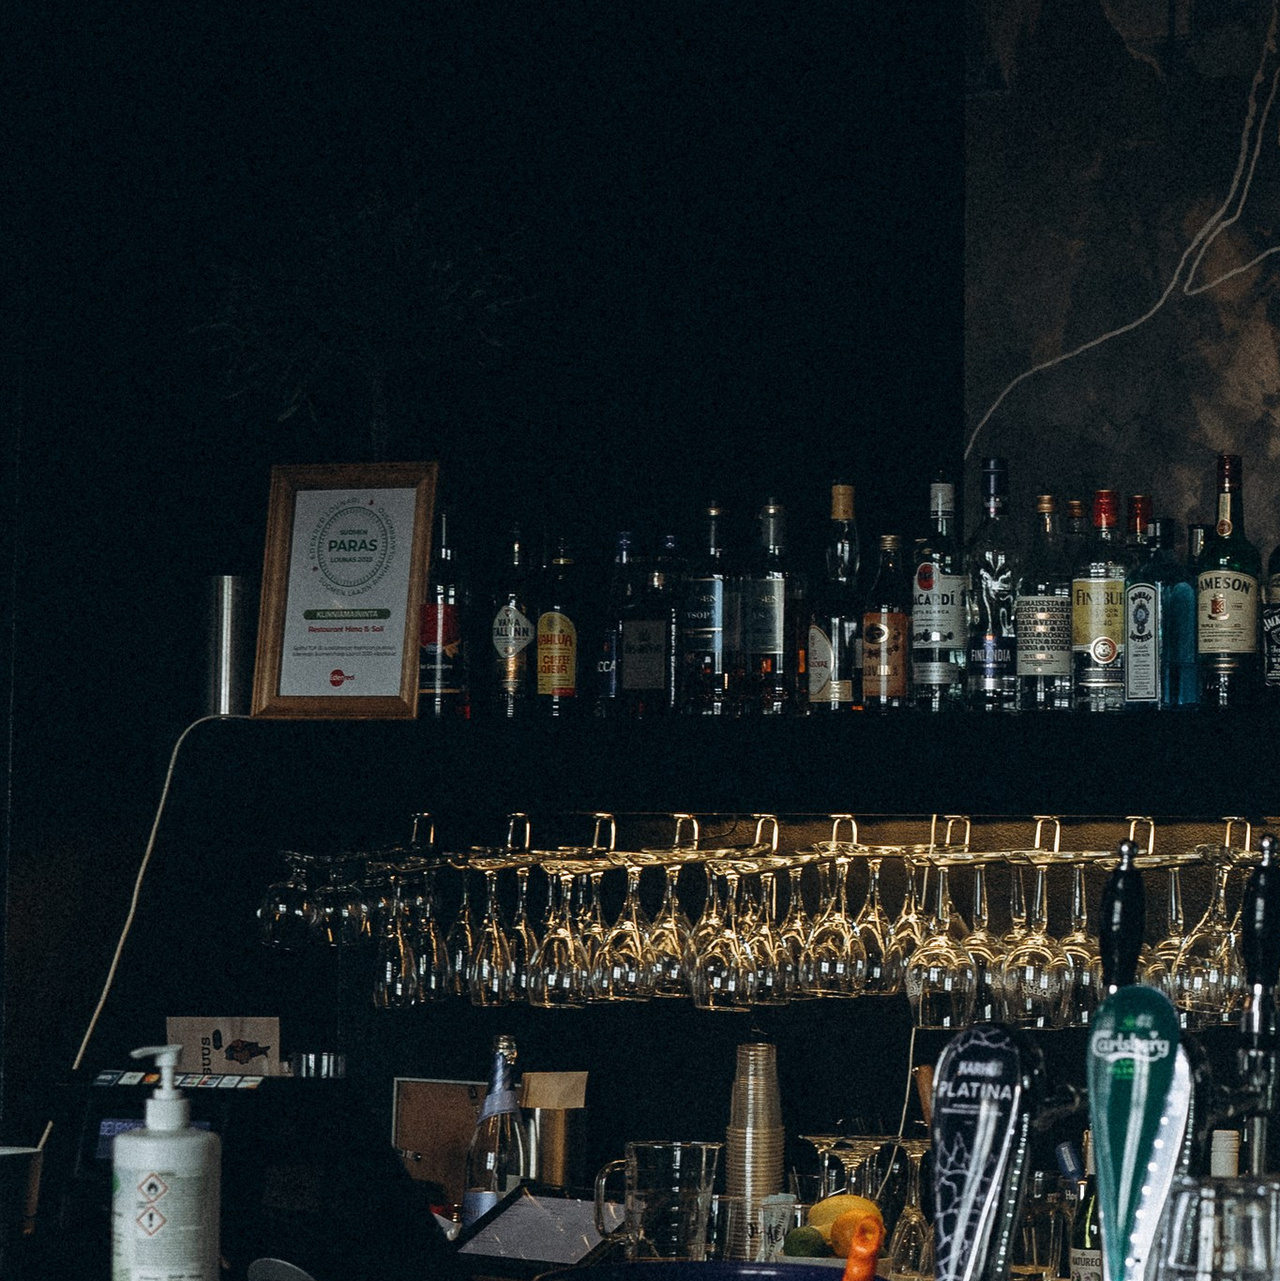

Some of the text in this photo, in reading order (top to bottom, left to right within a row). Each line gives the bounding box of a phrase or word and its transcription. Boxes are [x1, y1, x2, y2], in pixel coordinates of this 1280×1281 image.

[328, 538, 378, 552] PARAS
[1199, 576, 1253, 595] AMESON
[493, 626, 530, 637] TALLNN
[971, 649, 1011, 661] FINLNDIA
[1091, 1030, 1170, 1062] Carlsberg
[938, 1080, 1012, 1100] PLATINA
